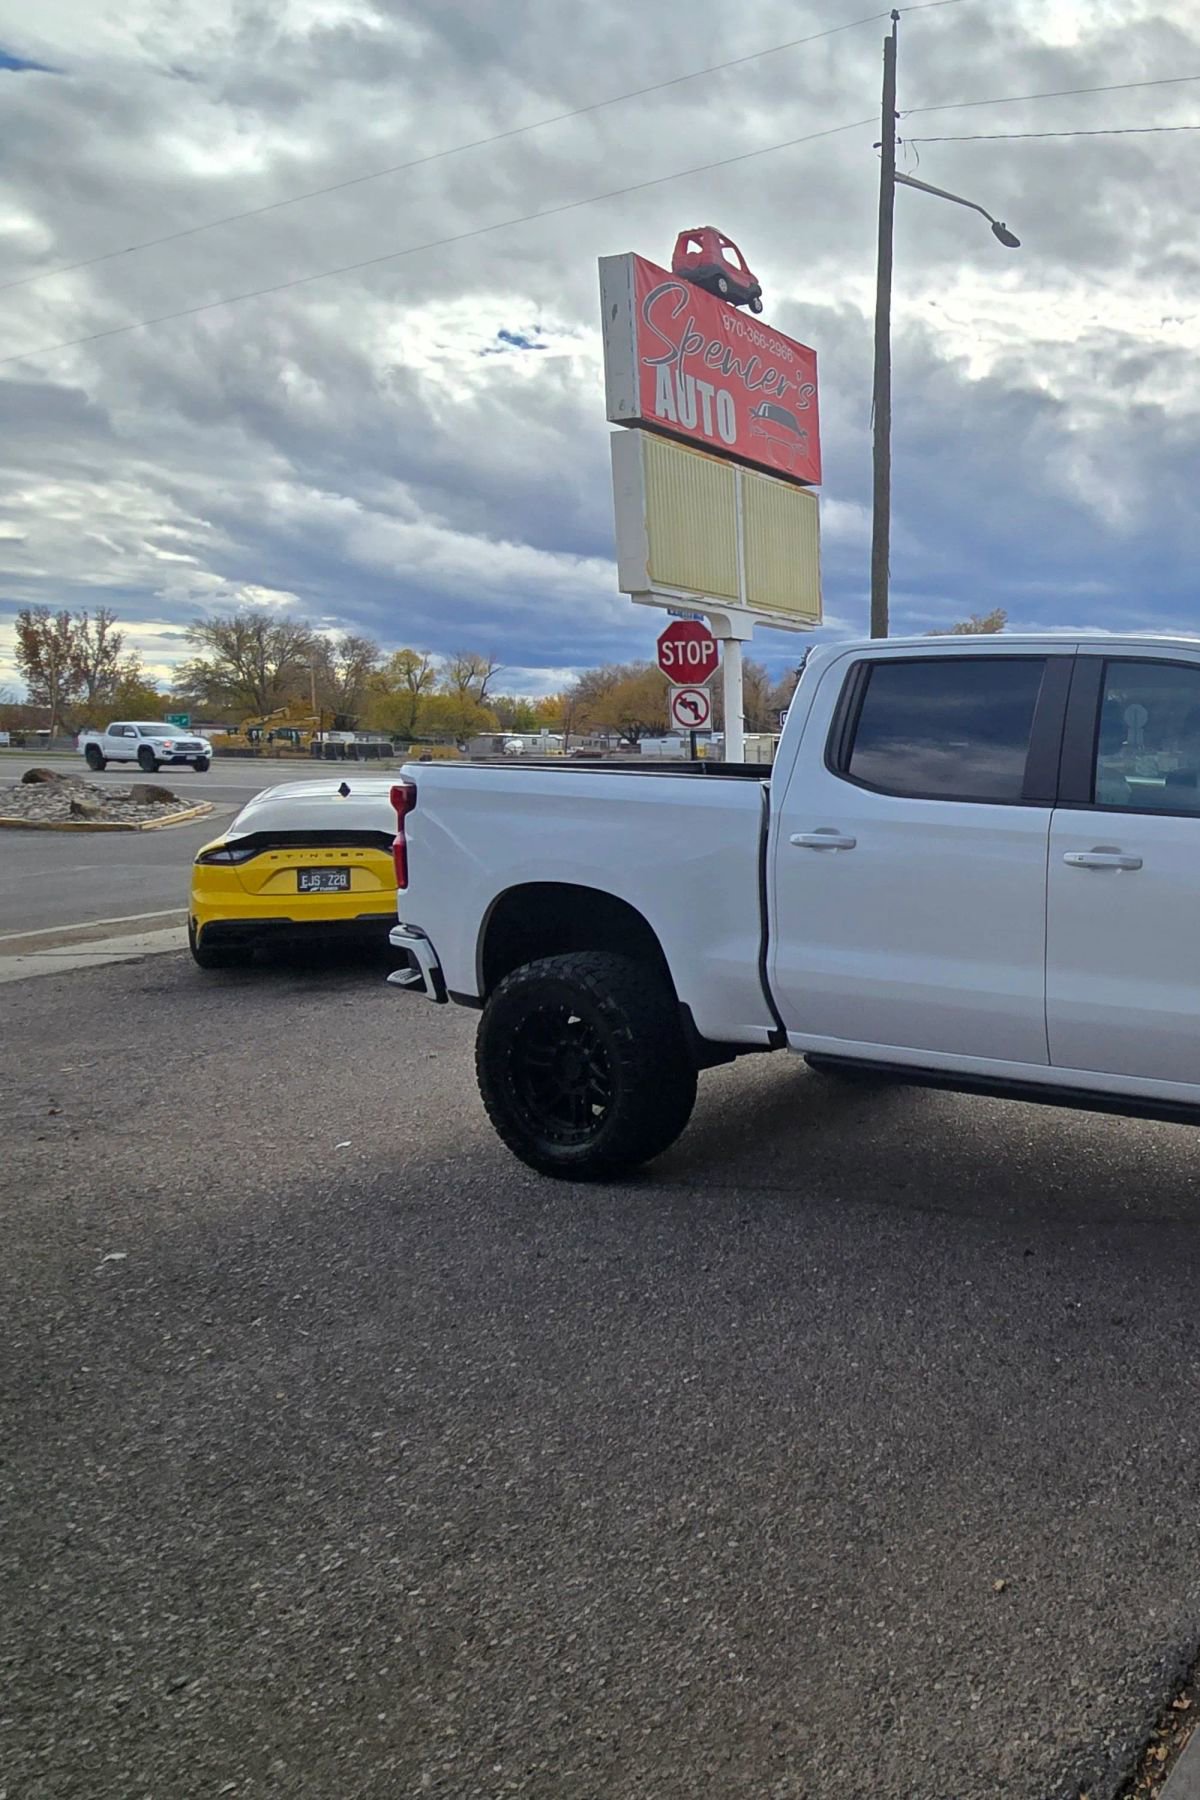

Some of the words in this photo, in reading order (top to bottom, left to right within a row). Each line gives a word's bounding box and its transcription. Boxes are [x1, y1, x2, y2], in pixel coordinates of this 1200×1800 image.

[642, 281, 817, 409] Spencer's
[655, 364, 737, 445] AUTO
[662, 641, 714, 665] STOP
